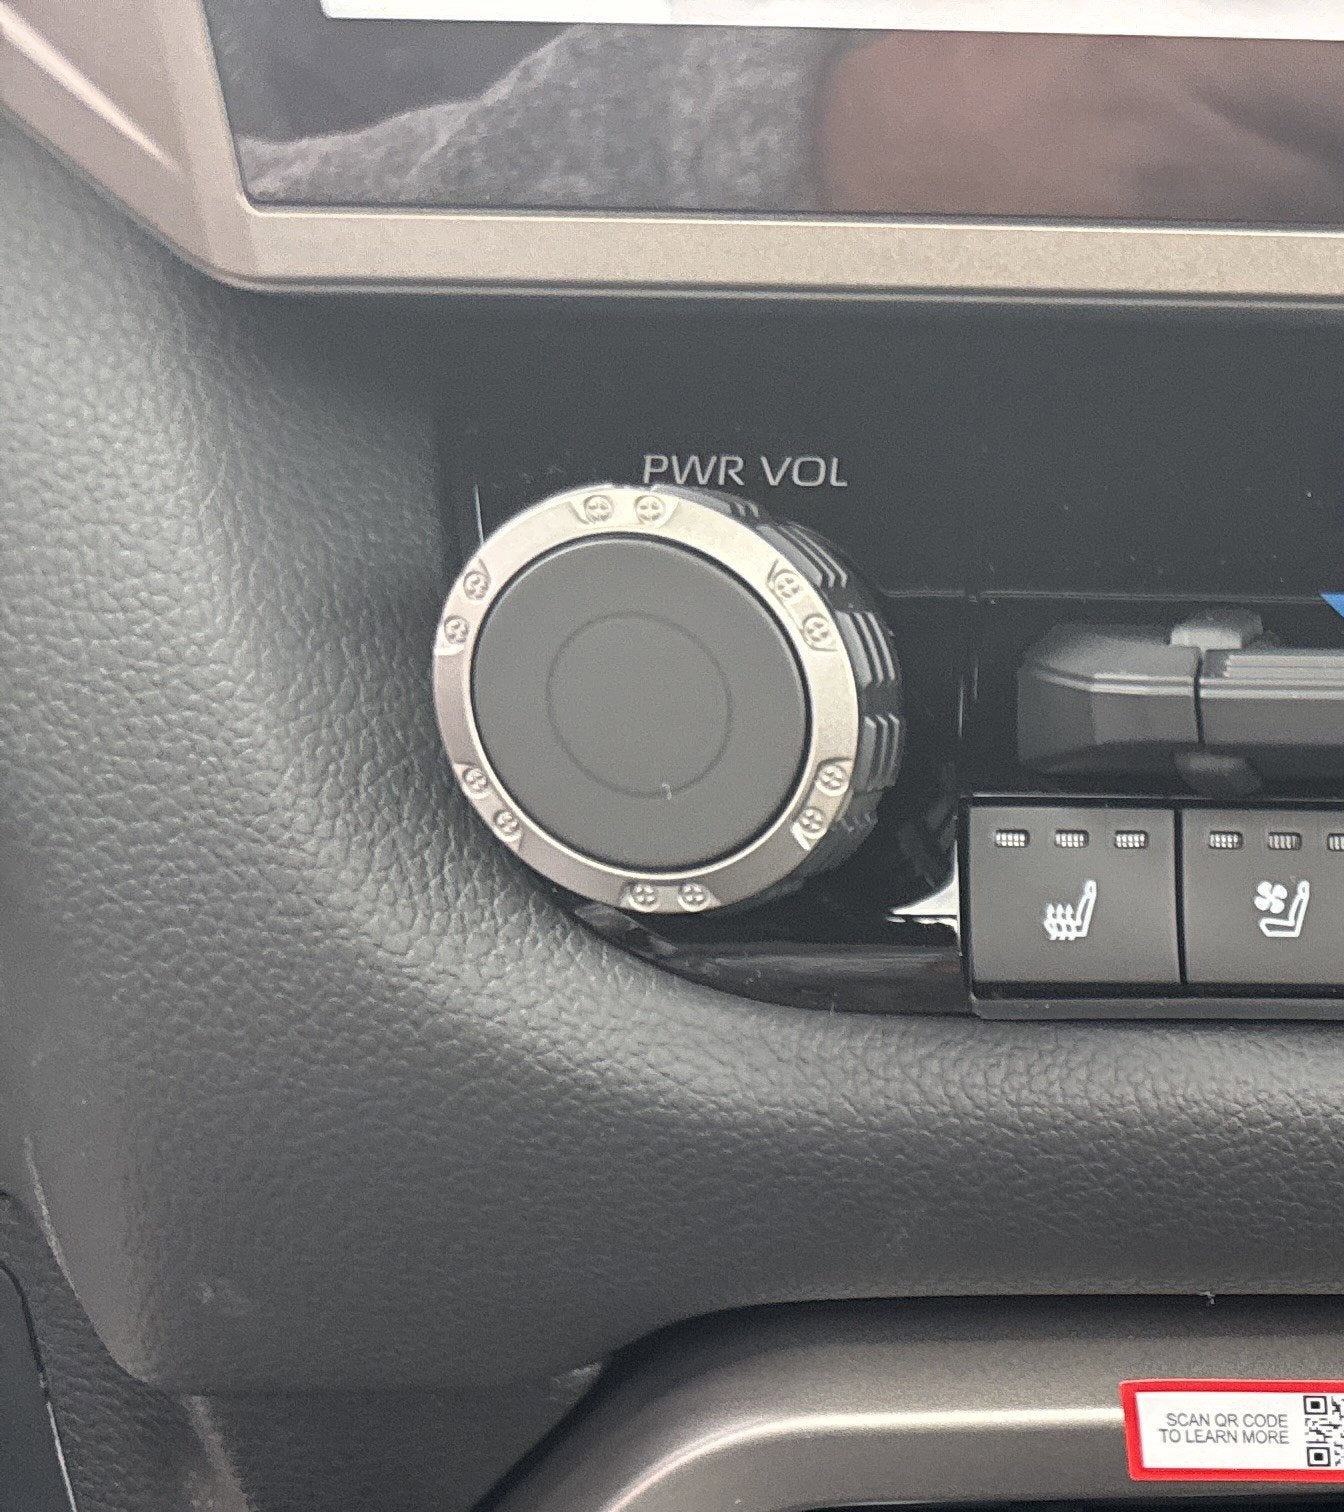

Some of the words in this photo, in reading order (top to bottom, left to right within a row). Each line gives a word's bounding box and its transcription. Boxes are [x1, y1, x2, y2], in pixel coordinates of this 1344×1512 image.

[643, 455, 745, 485] PWR
[760, 456, 848, 487] VOL
[1166, 1413, 1211, 1428] SCAN
[1215, 1413, 1239, 1428] QR
[1242, 1413, 1288, 1428] CODE
[1158, 1428, 1181, 1443] TO
[1185, 1429, 1238, 1444] LEARN
[1242, 1430, 1290, 1445] MORE
